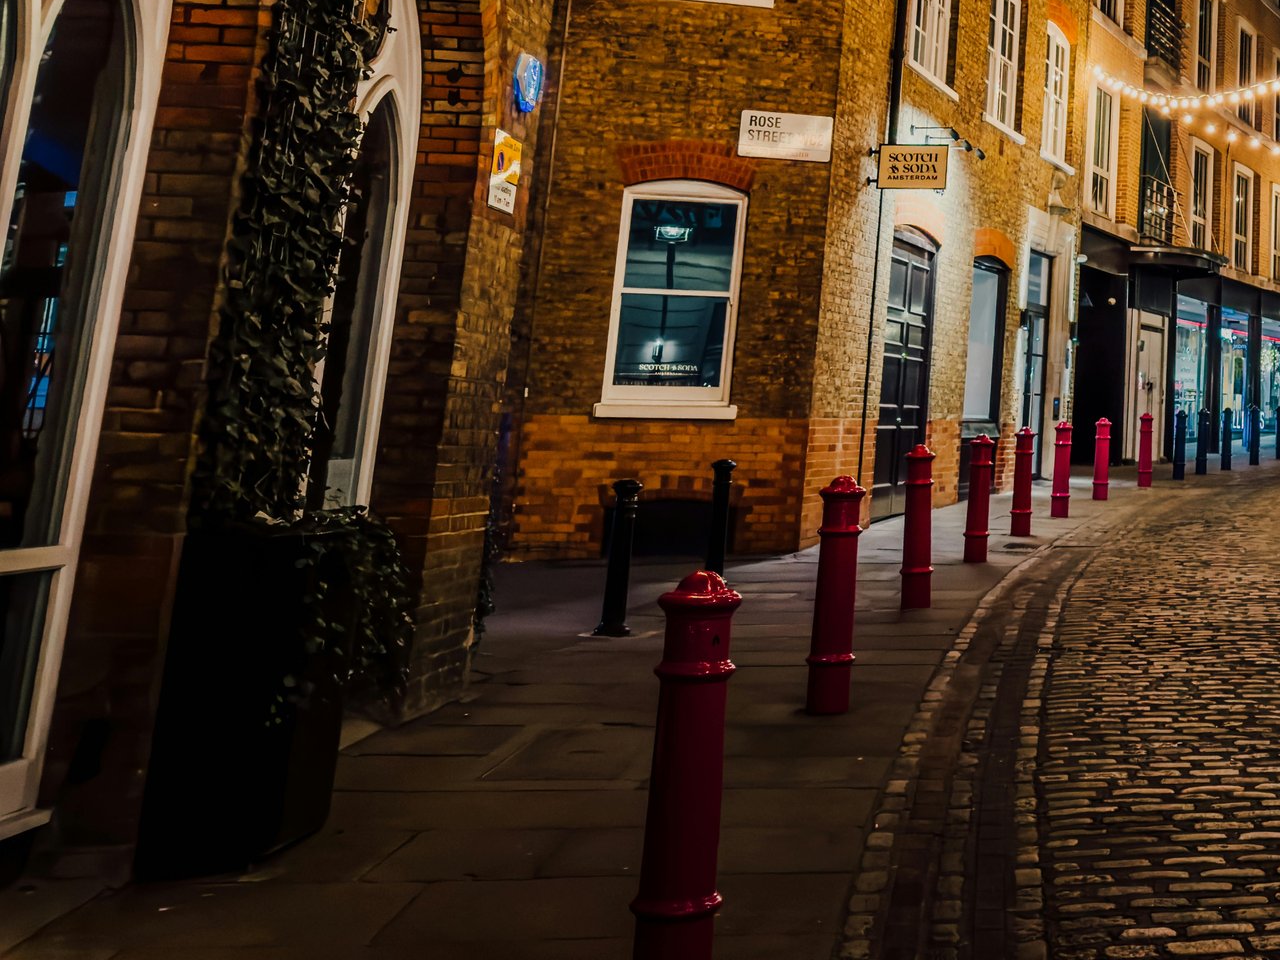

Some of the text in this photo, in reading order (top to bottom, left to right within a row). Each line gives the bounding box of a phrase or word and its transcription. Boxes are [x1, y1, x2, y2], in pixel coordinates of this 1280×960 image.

[749, 115, 782, 129] ROSE
[888, 152, 938, 163] SCOTCH
[888, 163, 938, 174] & SODA
[638, 363, 670, 371] SCOTCH
